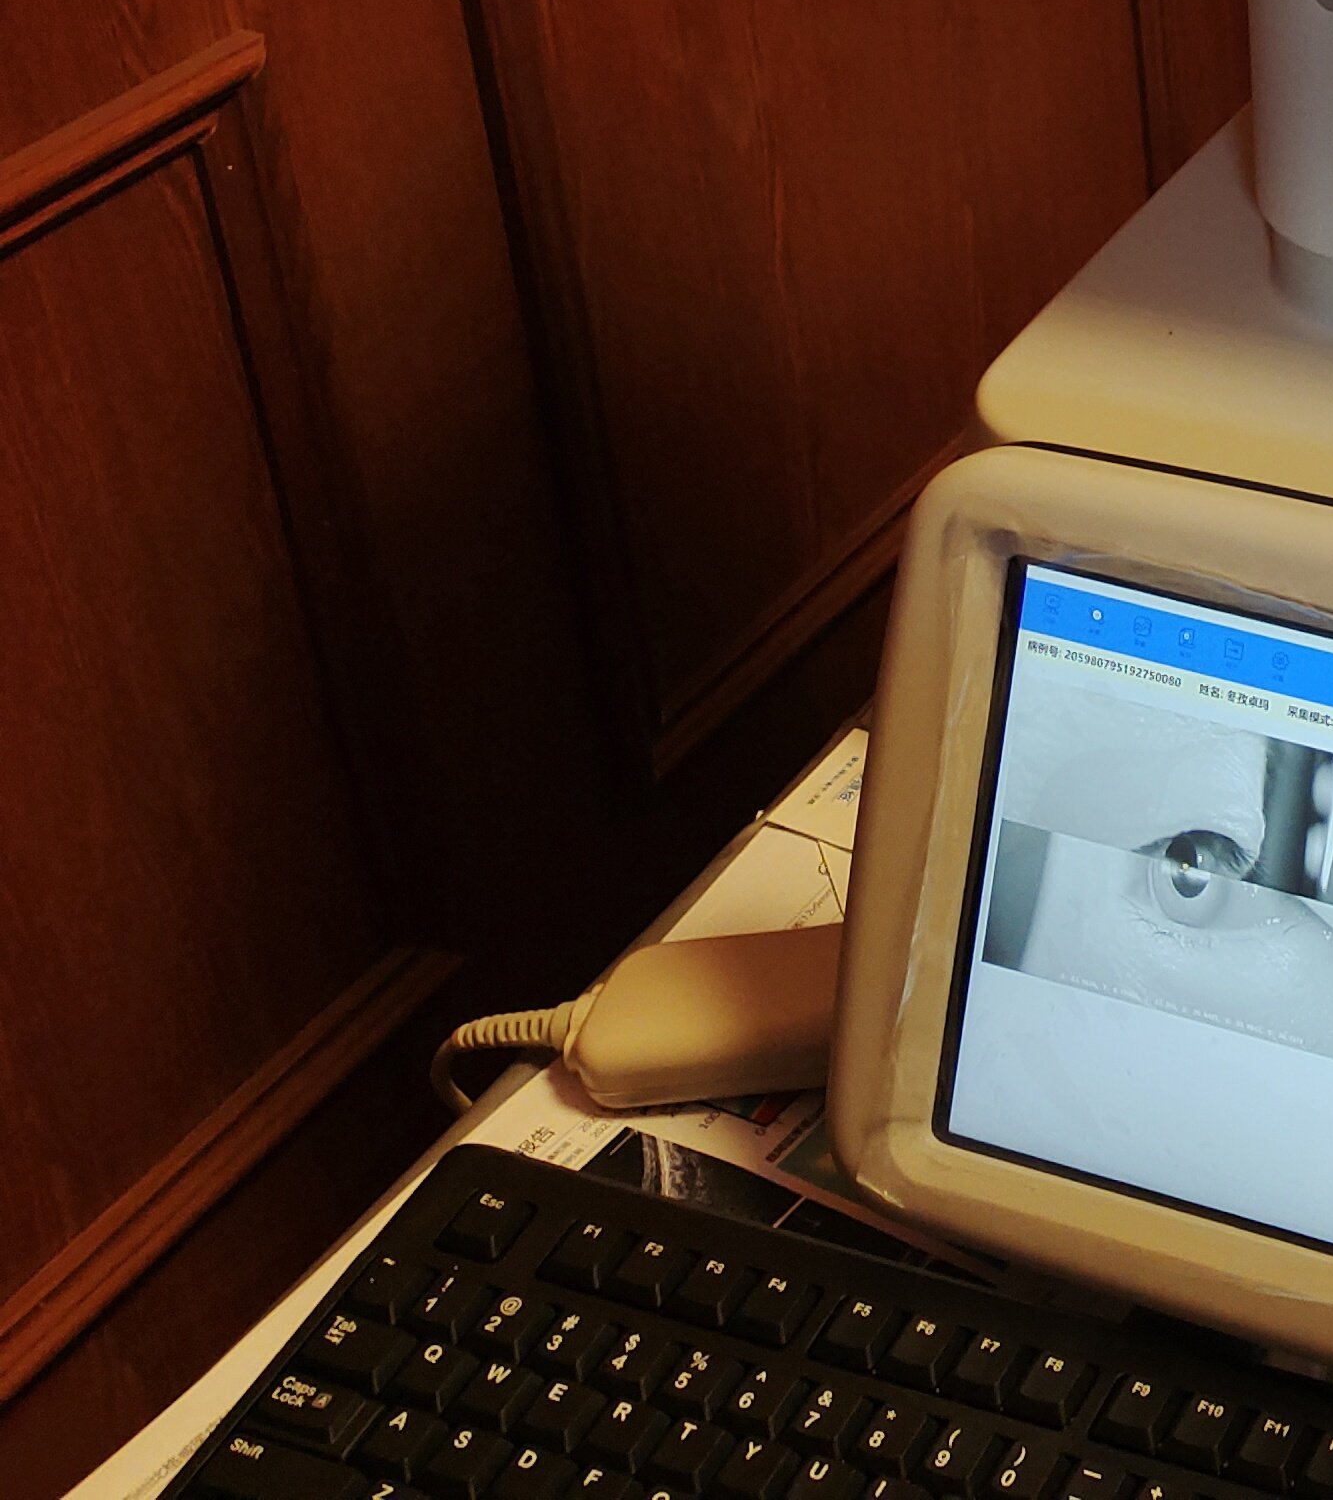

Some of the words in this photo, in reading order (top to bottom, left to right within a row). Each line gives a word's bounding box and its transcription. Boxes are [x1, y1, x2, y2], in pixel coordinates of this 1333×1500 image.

[479, 1193, 505, 1210] Esc
[583, 1224, 602, 1239] F1
[644, 1241, 664, 1256] F2
[705, 1260, 725, 1274] F3
[767, 1277, 787, 1293] F4
[425, 1297, 438, 1312] 1
[499, 1295, 523, 1317] @
[852, 1302, 873, 1317] F5
[332, 1314, 358, 1334] Tab
[483, 1315, 503, 1333] 2
[916, 1320, 936, 1336] F6
[546, 1334, 563, 1351] 3
[624, 1333, 641, 1352] $
[980, 1337, 1001, 1353] F7
[424, 1344, 443, 1364] Q
[611, 1354, 628, 1370] 4
[690, 1351, 709, 1371] %
[1044, 1356, 1064, 1372] F8
[487, 1363, 512, 1384] W
[674, 1371, 692, 1389] 5
[282, 1375, 317, 1398] Caps
[548, 1383, 569, 1402] E
[1131, 1381, 1151, 1397] F9
[271, 1386, 305, 1409] Lock
[738, 1391, 755, 1409] 6
[817, 1390, 833, 1408] &
[612, 1401, 633, 1422] R
[1197, 1399, 1224, 1418] F10
[388, 1411, 408, 1431] A
[804, 1410, 821, 1428] 7
[1263, 1419, 1290, 1437] F11
[453, 1430, 473, 1449] S
[680, 1421, 698, 1441] T
[868, 1430, 885, 1448] 8
[230, 1438, 264, 1460] Shift
[745, 1441, 762, 1461] Y
[517, 1449, 538, 1469] D
[934, 1449, 951, 1468] 9
[583, 1469, 603, 1486] F
[809, 1461, 829, 1480] U
[1000, 1469, 1017, 1487] 0
[372, 1483, 394, 1500] Z
[874, 1480, 887, 1498] I
